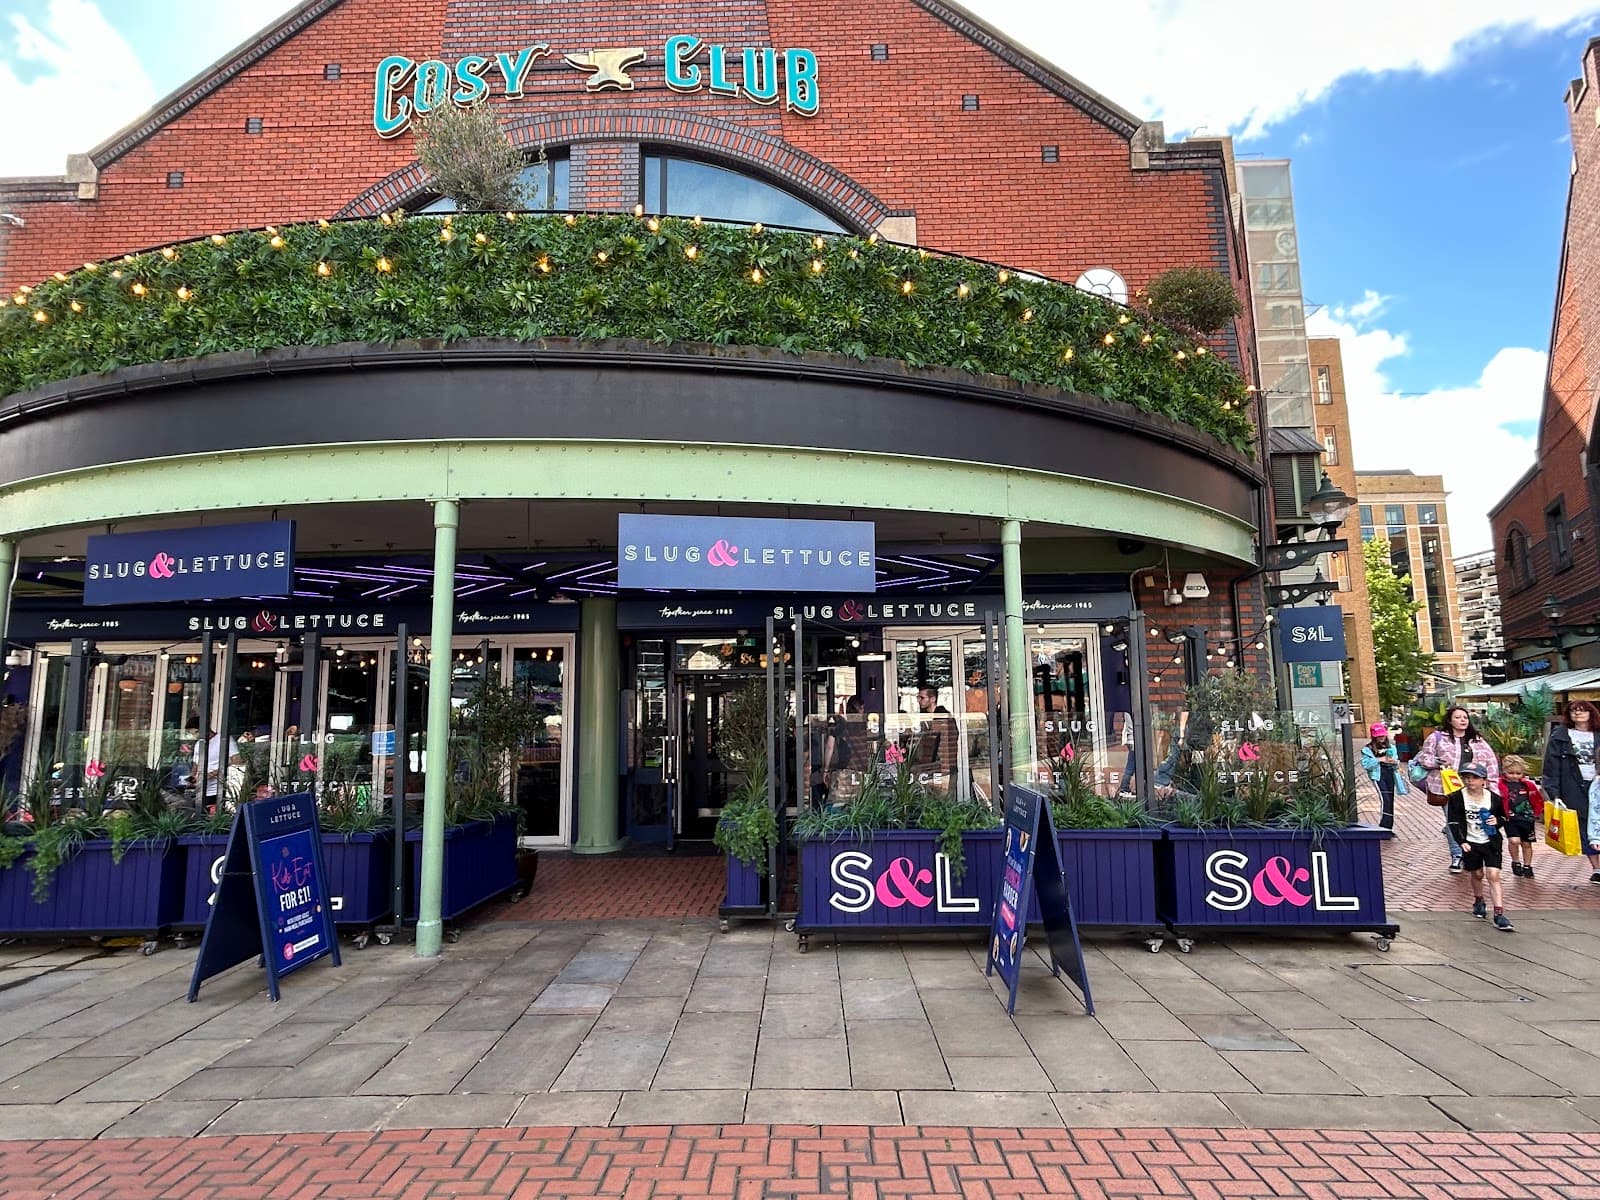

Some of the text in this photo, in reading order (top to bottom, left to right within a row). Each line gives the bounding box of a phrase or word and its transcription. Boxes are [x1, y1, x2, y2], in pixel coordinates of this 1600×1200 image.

[373, 34, 820, 140] COSY CLUB
[624, 539, 871, 567] SLUG & LETTUCE
[88, 551, 286, 580] SLUG & LETTUCE
[188, 609, 385, 632] SLUG & LETTUCE
[773, 599, 976, 622] SLUG & LETTUCE
[1292, 625, 1334, 644] S&L
[1044, 720, 1097, 732] SLUG
[1220, 720, 1274, 732] SLUG
[830, 851, 980, 912] S&L
[1205, 850, 1360, 911] S&L
[280, 890, 298, 912] FOR
